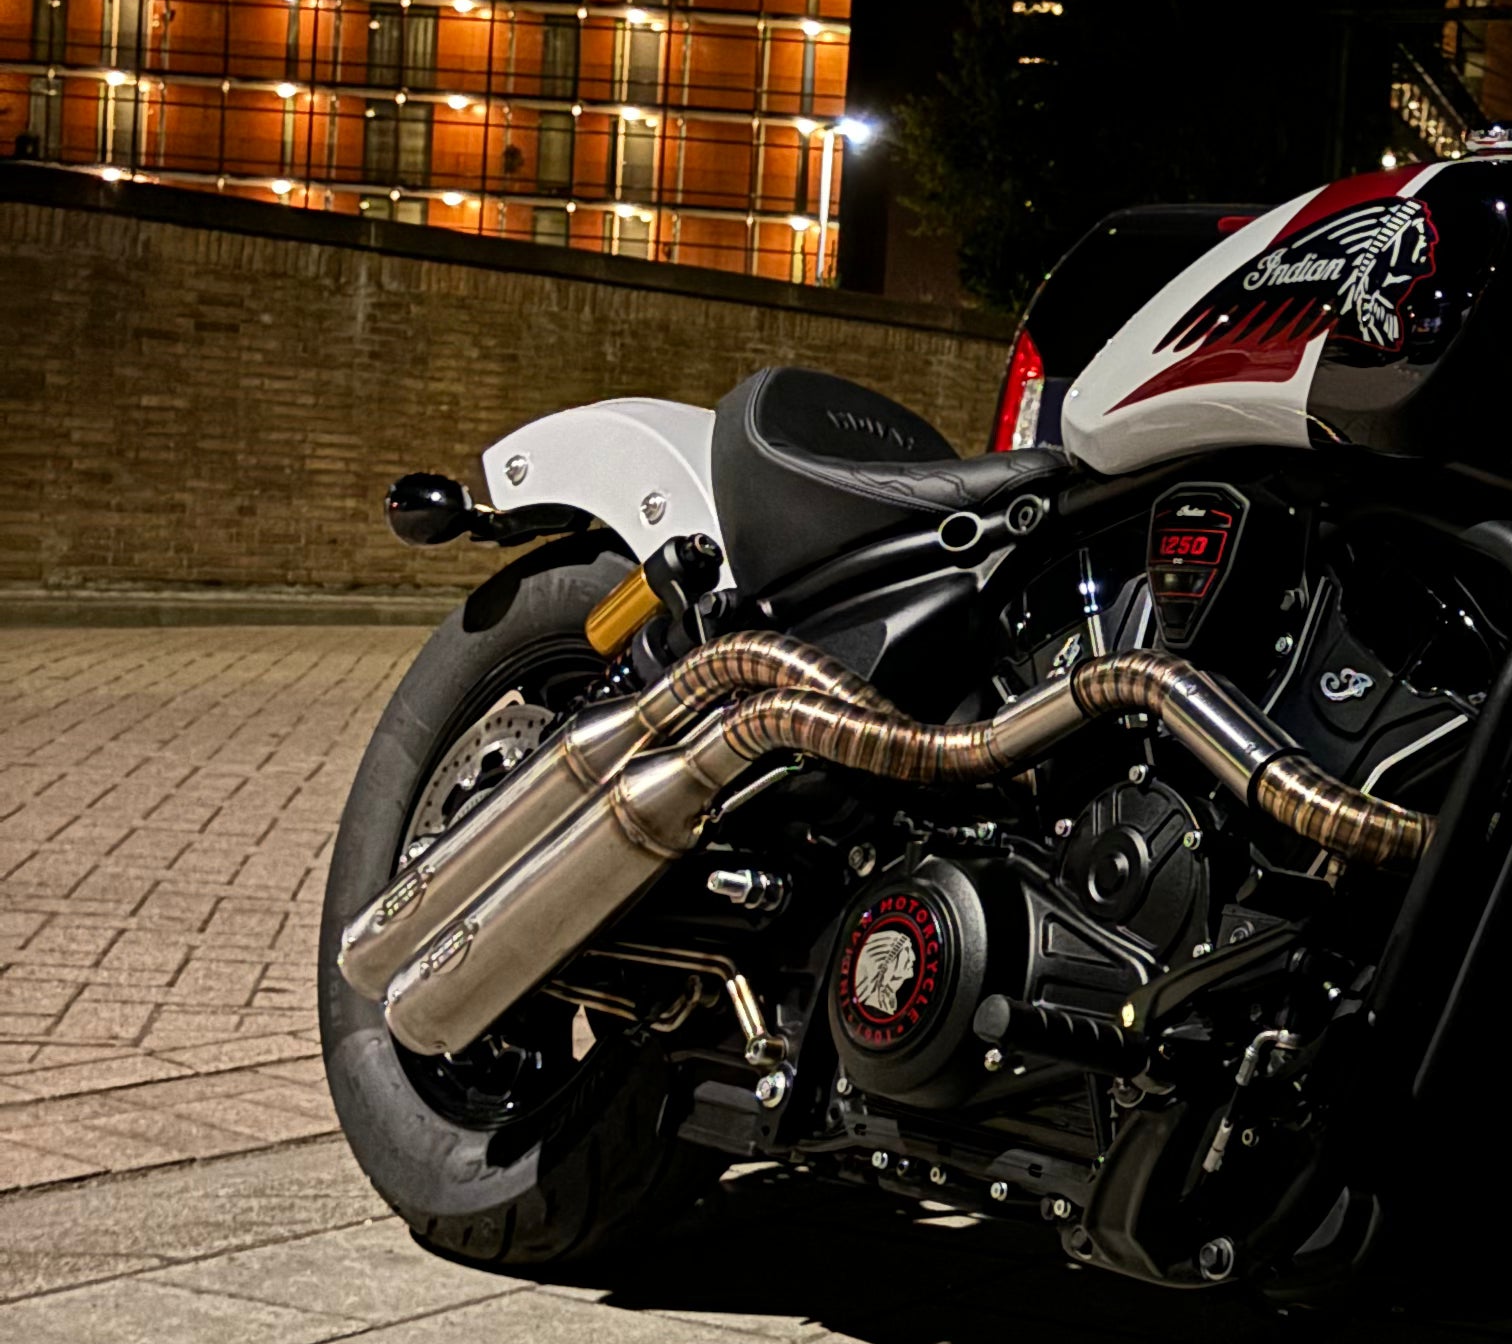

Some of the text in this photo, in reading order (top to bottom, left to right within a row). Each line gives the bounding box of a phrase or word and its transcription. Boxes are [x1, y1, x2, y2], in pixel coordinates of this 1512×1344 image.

[1243, 247, 1346, 291] Indian
[1160, 535, 1208, 556] 1250
[879, 895, 940, 1024] MOTORCYCLE
